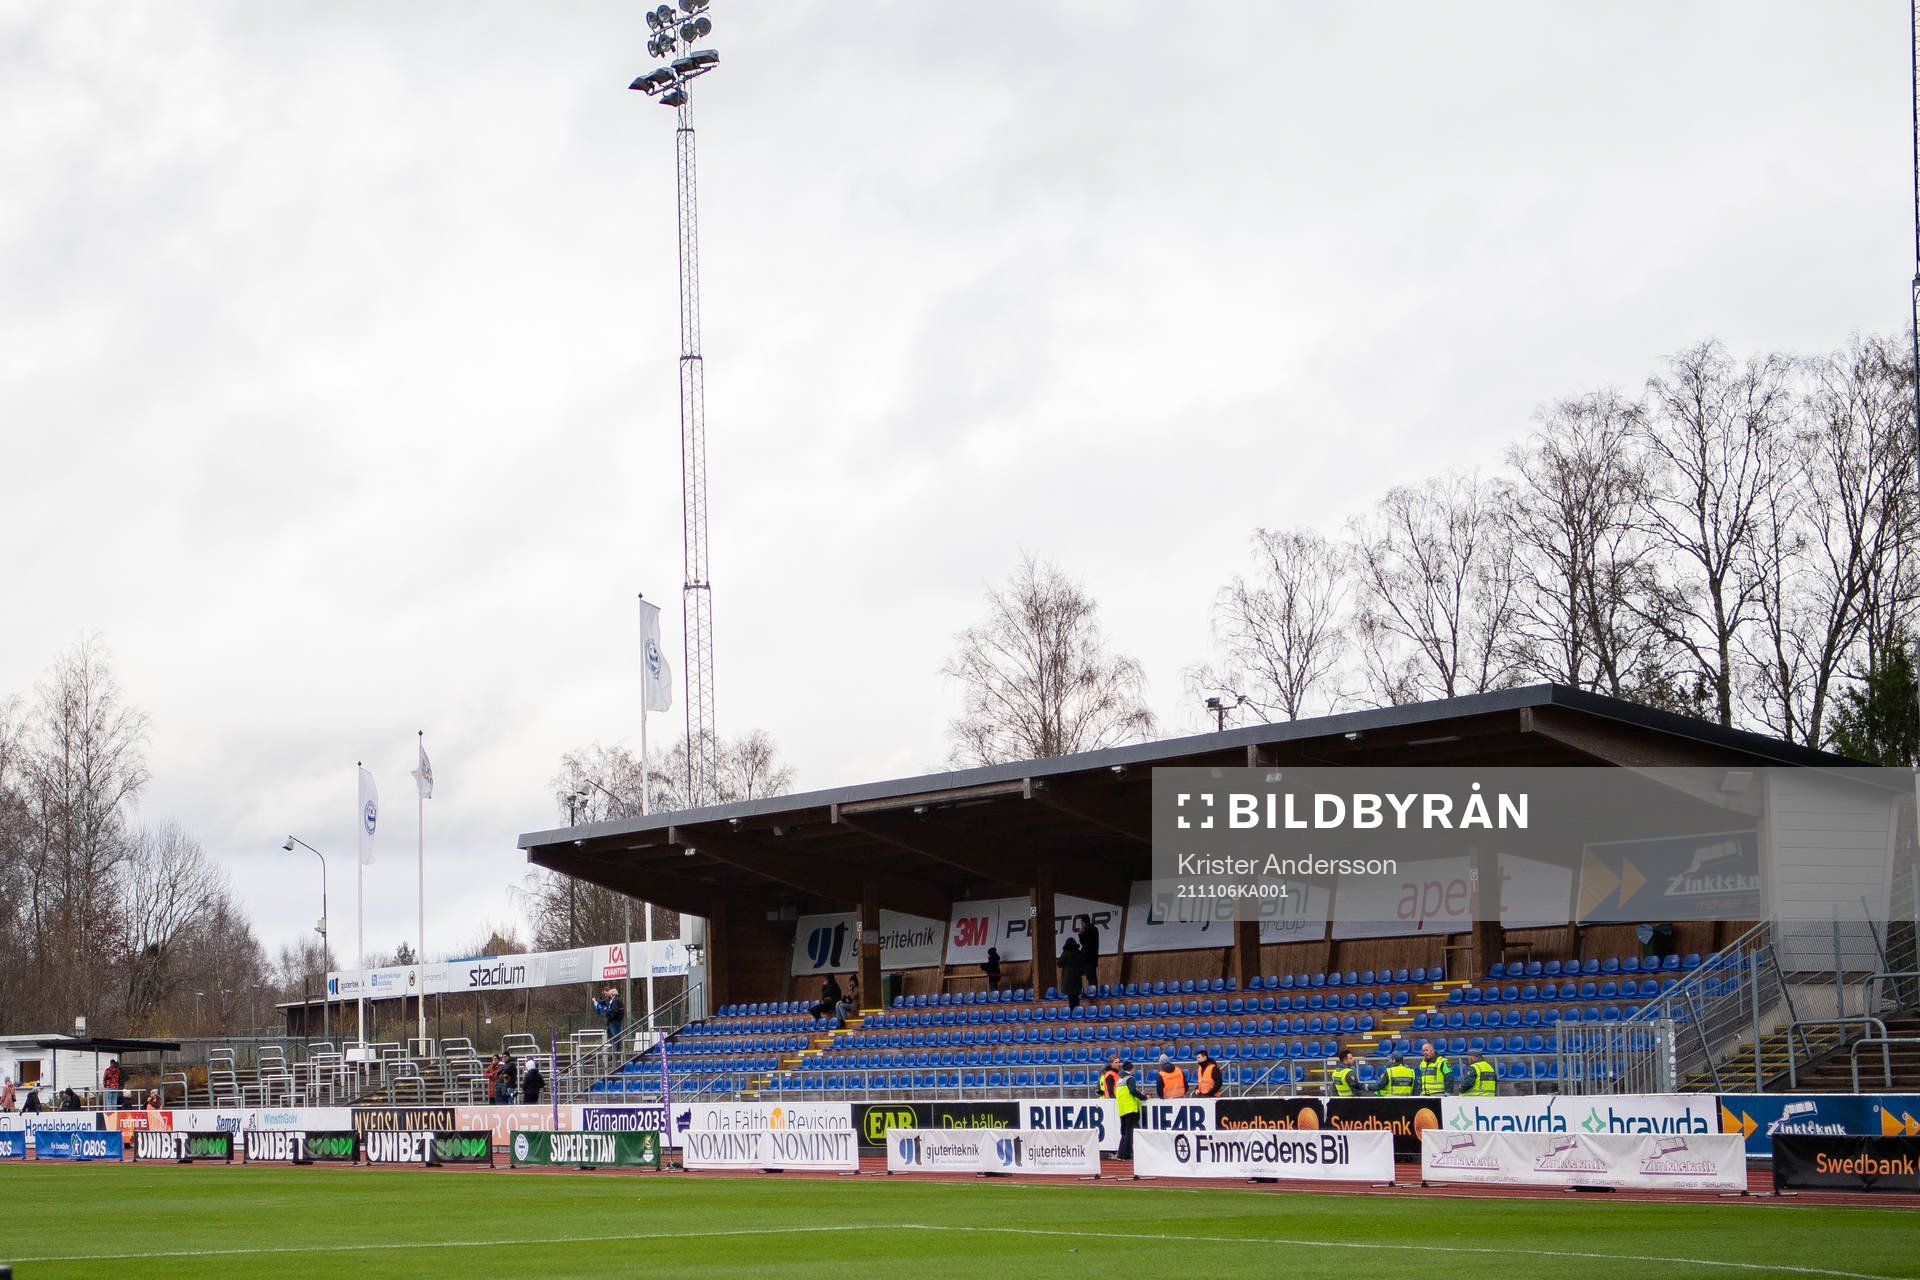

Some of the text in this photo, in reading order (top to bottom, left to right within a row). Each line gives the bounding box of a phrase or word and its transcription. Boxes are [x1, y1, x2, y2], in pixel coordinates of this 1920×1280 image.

[953, 917, 989, 948] 3M
[1006, 911, 1111, 938] PTOR
[609, 946, 624, 964] ICA
[469, 962, 525, 987] stadium
[25, 1119, 92, 1136] Handelsbanken
[707, 1109, 847, 1130] Ola Fälth Revision
[870, 1112, 913, 1138] EAB
[943, 1113, 1009, 1130] Det håller
[1141, 1105, 1205, 1131] UFAB
[1220, 1115, 1294, 1131] Swedbank
[1330, 1115, 1411, 1135] Swedbank
[83, 1139, 107, 1156] OBOS
[137, 1132, 189, 1159] UNIBET
[247, 1132, 307, 1160] UNIBET
[367, 1131, 434, 1162] UNIBET
[550, 1134, 616, 1163] SUPERETTAN
[687, 1133, 852, 1161] NOMINIT NOMINIT
[926, 1144, 980, 1164] gjuteriteknik
[1028, 1145, 1086, 1166] gjuteriteknik
[1196, 1134, 1349, 1165] Finnvedens Bil
[1815, 1152, 1914, 1175] Swedbank
